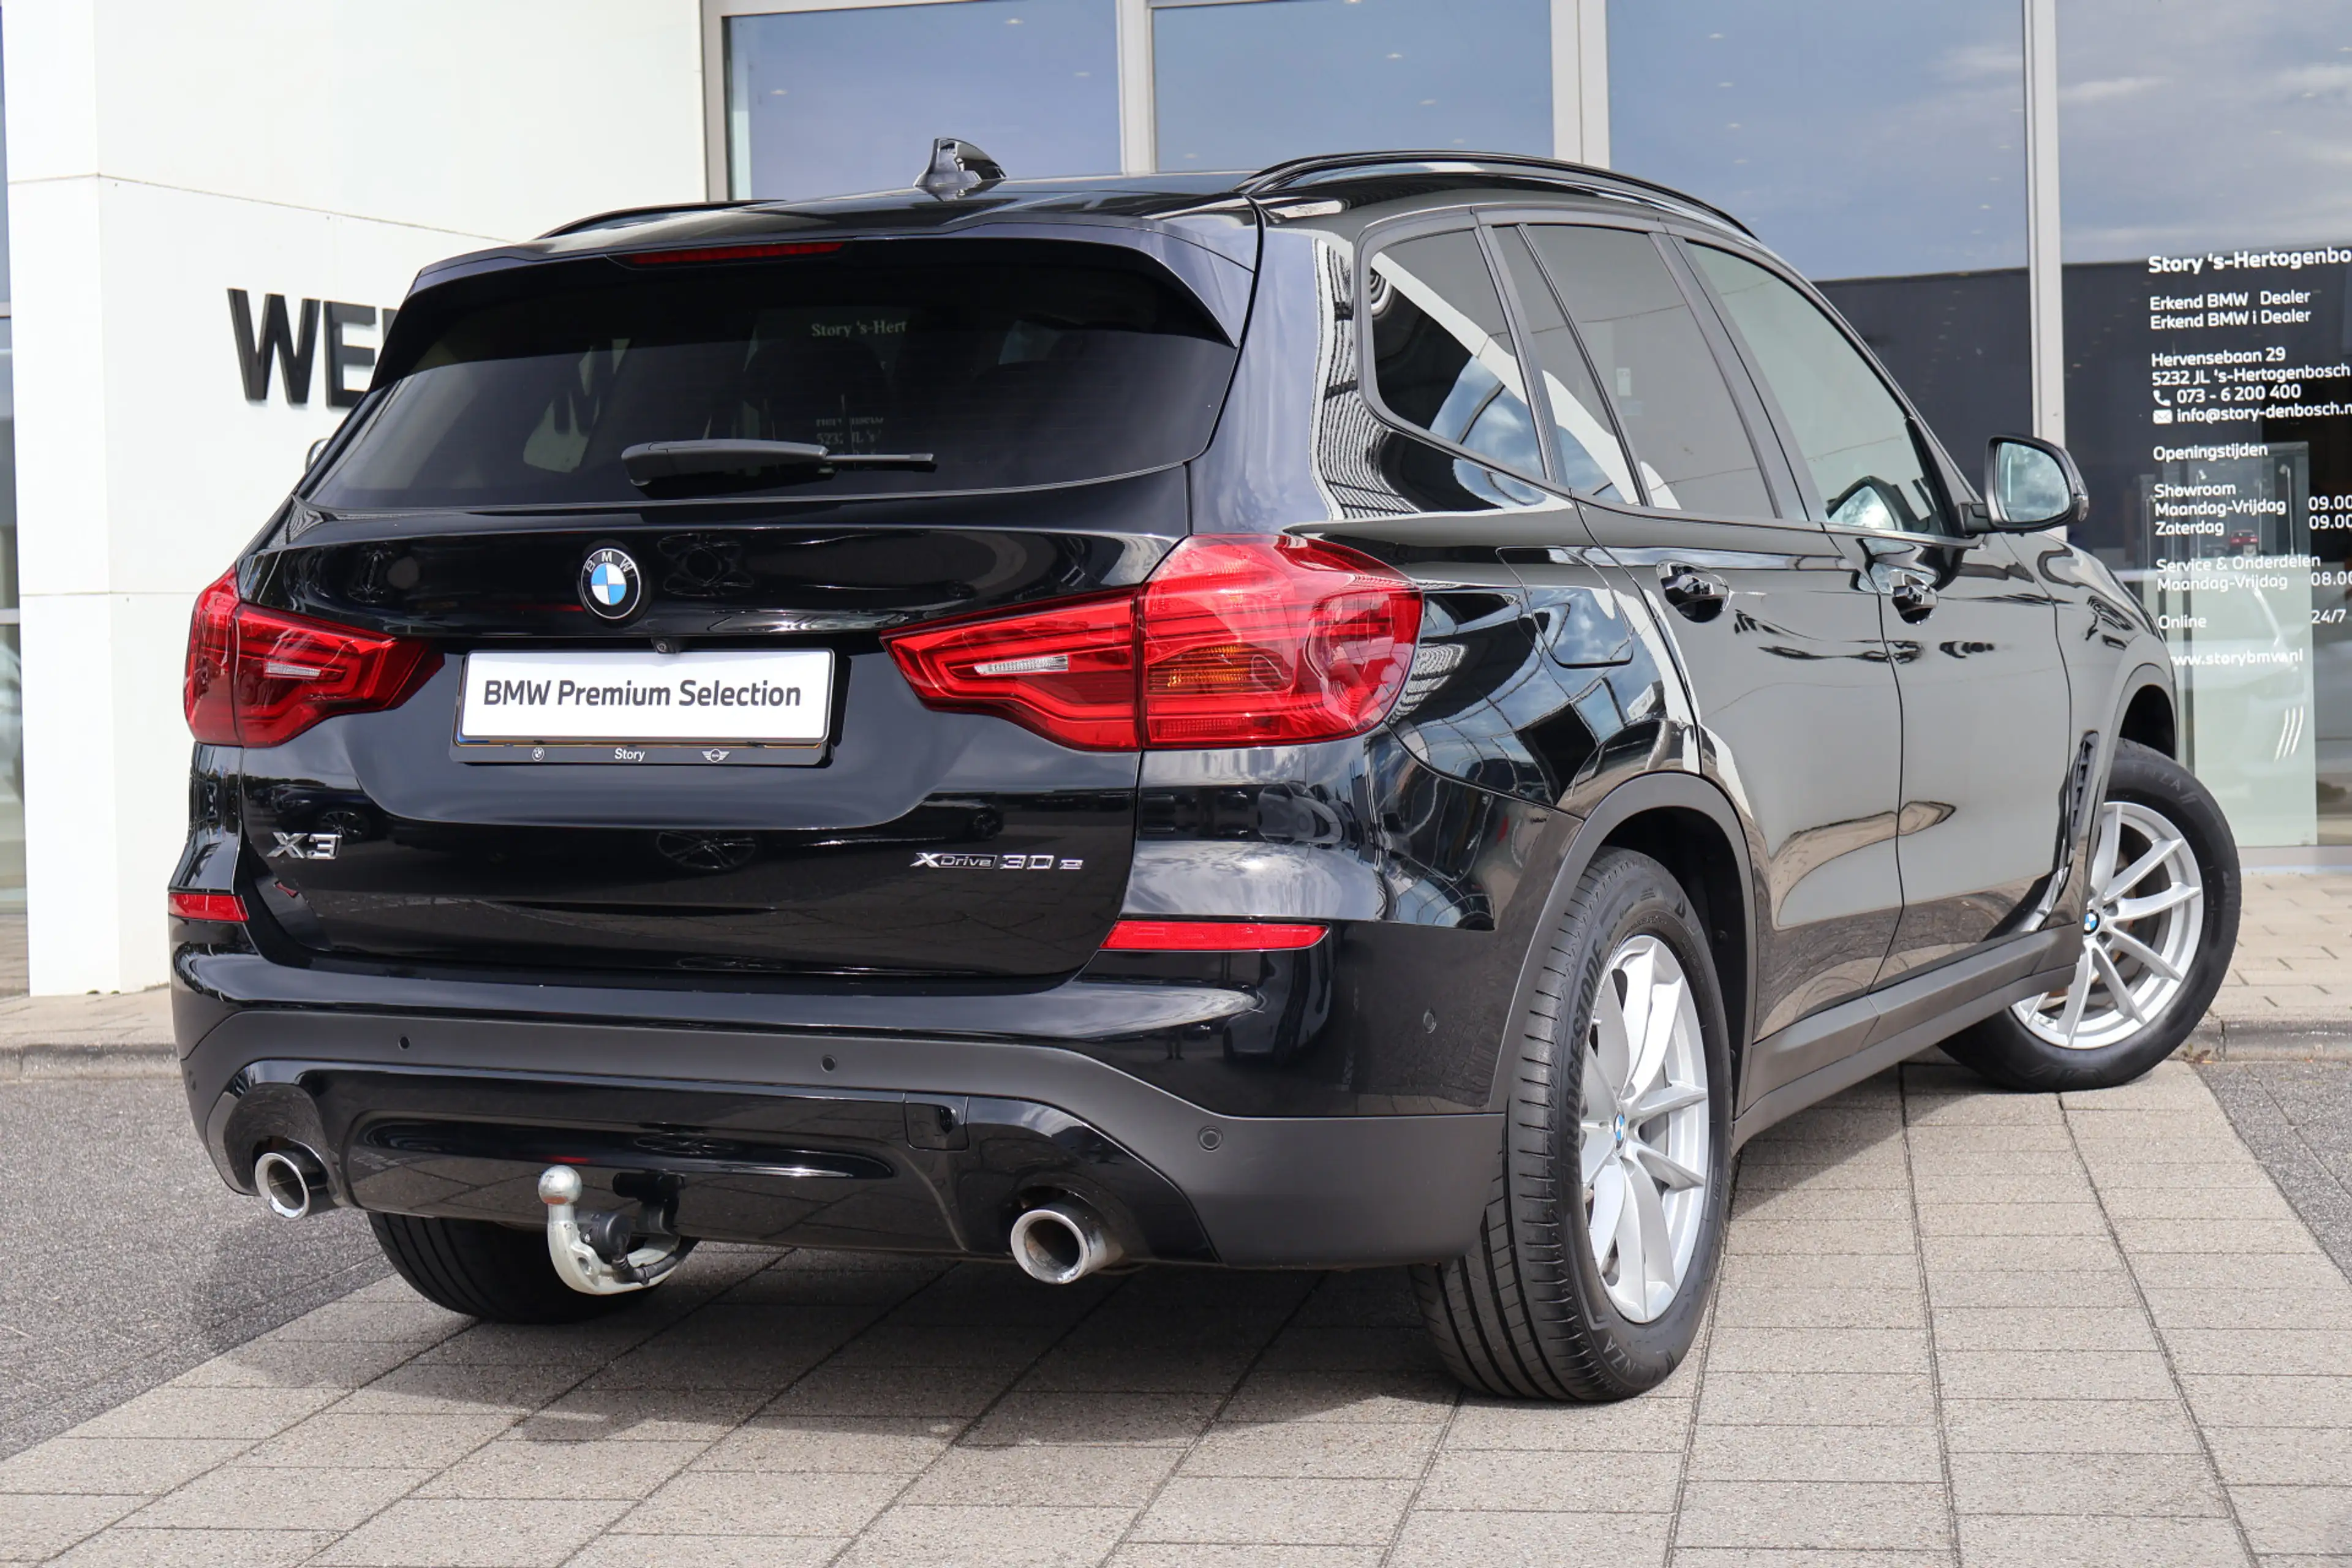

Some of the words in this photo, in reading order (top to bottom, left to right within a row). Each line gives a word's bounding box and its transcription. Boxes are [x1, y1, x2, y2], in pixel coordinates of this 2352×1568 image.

[2148, 255, 2203, 274] Story
[2150, 295, 2203, 311] Erkend
[2207, 292, 2249, 307] BMW
[2260, 289, 2311, 305] Dealer
[2150, 313, 2203, 330] Erkend
[2207, 311, 2250, 327] BMW
[2252, 309, 2257, 325] i
[2261, 308, 2312, 324] Dealer
[811, 323, 852, 337] Story
[227, 288, 399, 409] WE
[2151, 349, 2262, 368] Hervensebaan
[2266, 347, 2286, 361] 29
[2152, 371, 2190, 386] 5232
[2193, 369, 2211, 385] JL
[2214, 363, 2351, 383] 's-Hertogenbosch
[2177, 388, 2206, 404] 073
[2220, 387, 2231, 402] 6
[2234, 385, 2266, 401] 200
[2269, 383, 2302, 399] 400
[2153, 442, 2268, 463] Openingstijden
[2154, 483, 2236, 499] Showroom
[2155, 499, 2286, 518] Maandag-Vrijdag
[2155, 520, 2225, 536] Zaterdag
[2156, 558, 2212, 573] Service
[2216, 557, 2228, 571] &
[2233, 554, 2321, 570] Onderdelen
[2157, 574, 2288, 592] Maandag-Vrijdag
[2158, 614, 2207, 630] Online
[2311, 608, 2346, 624] 24/7
[483, 679, 551, 706] BMW
[557, 680, 671, 706] Premium
[679, 679, 802, 707] Selection
[614, 747, 646, 762] Story
[266, 831, 342, 860] X3
